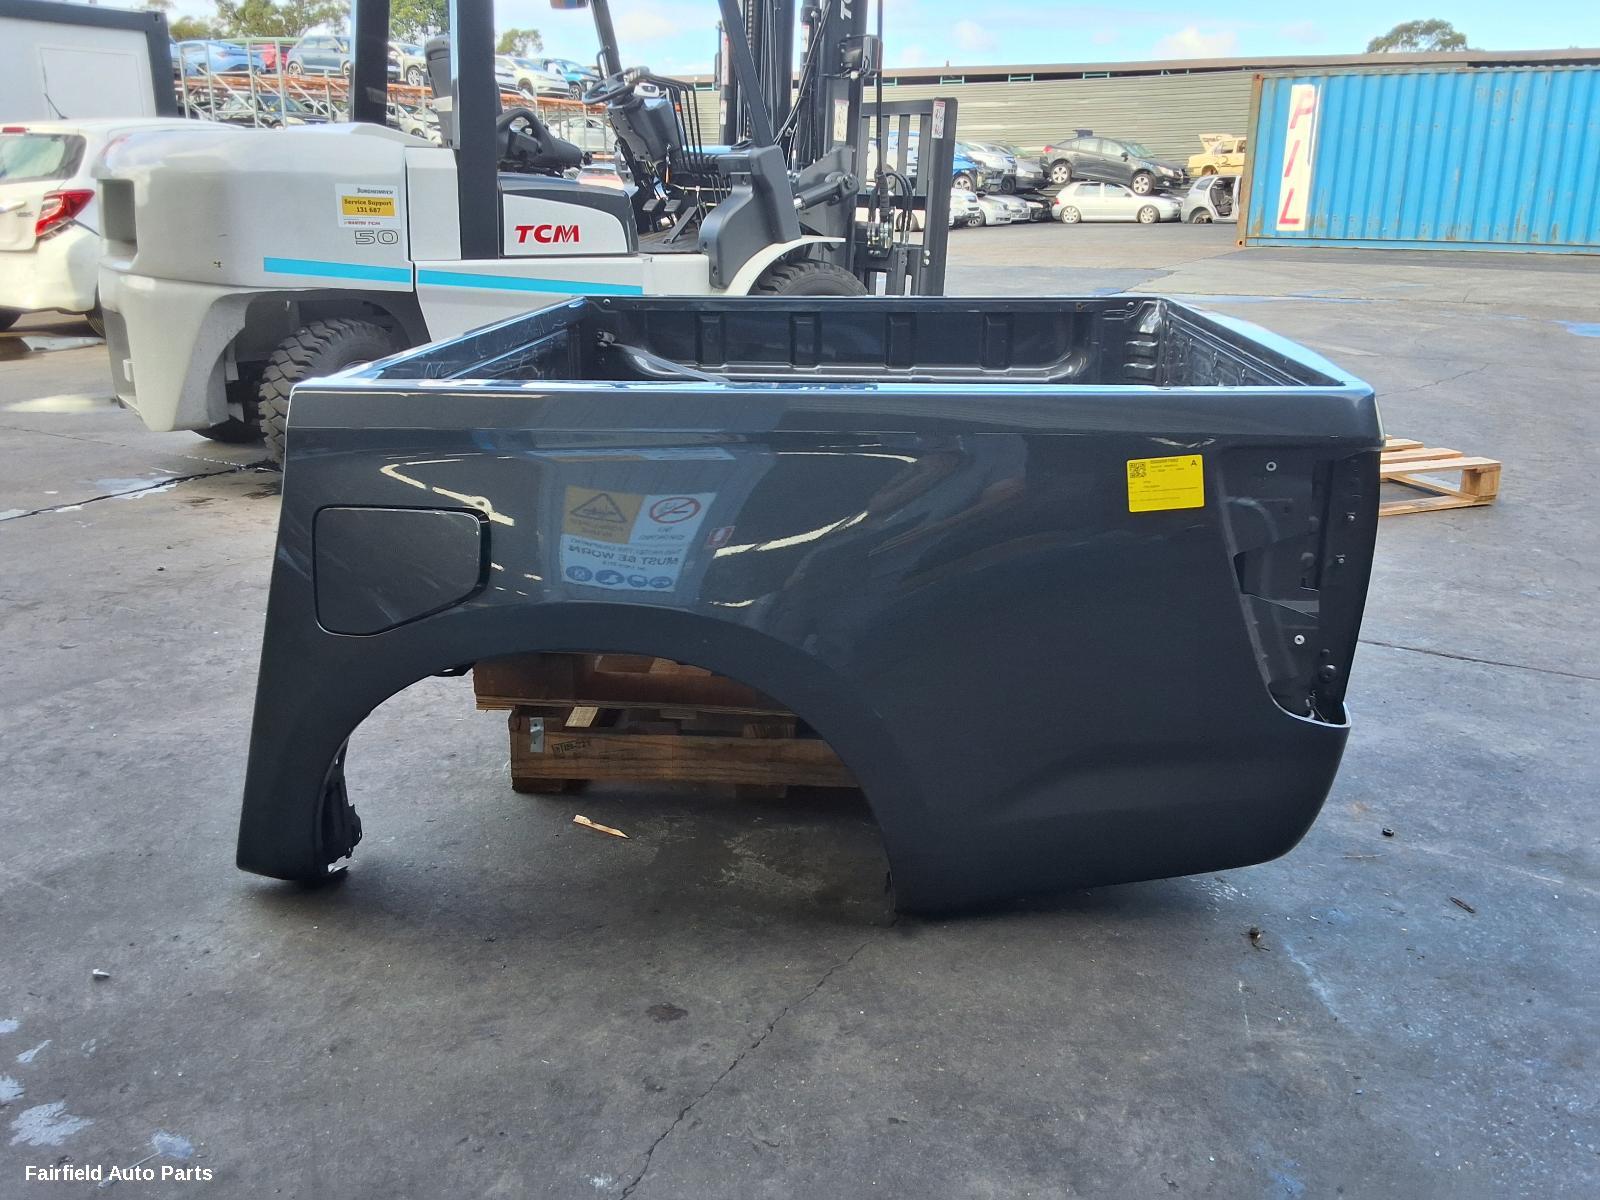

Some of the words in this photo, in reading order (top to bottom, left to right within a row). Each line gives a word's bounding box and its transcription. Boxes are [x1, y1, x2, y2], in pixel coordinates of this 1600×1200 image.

[1278, 89, 1315, 225] PIL
[367, 199, 392, 207] Support
[354, 229, 399, 245] 50
[515, 224, 580, 243] TCM
